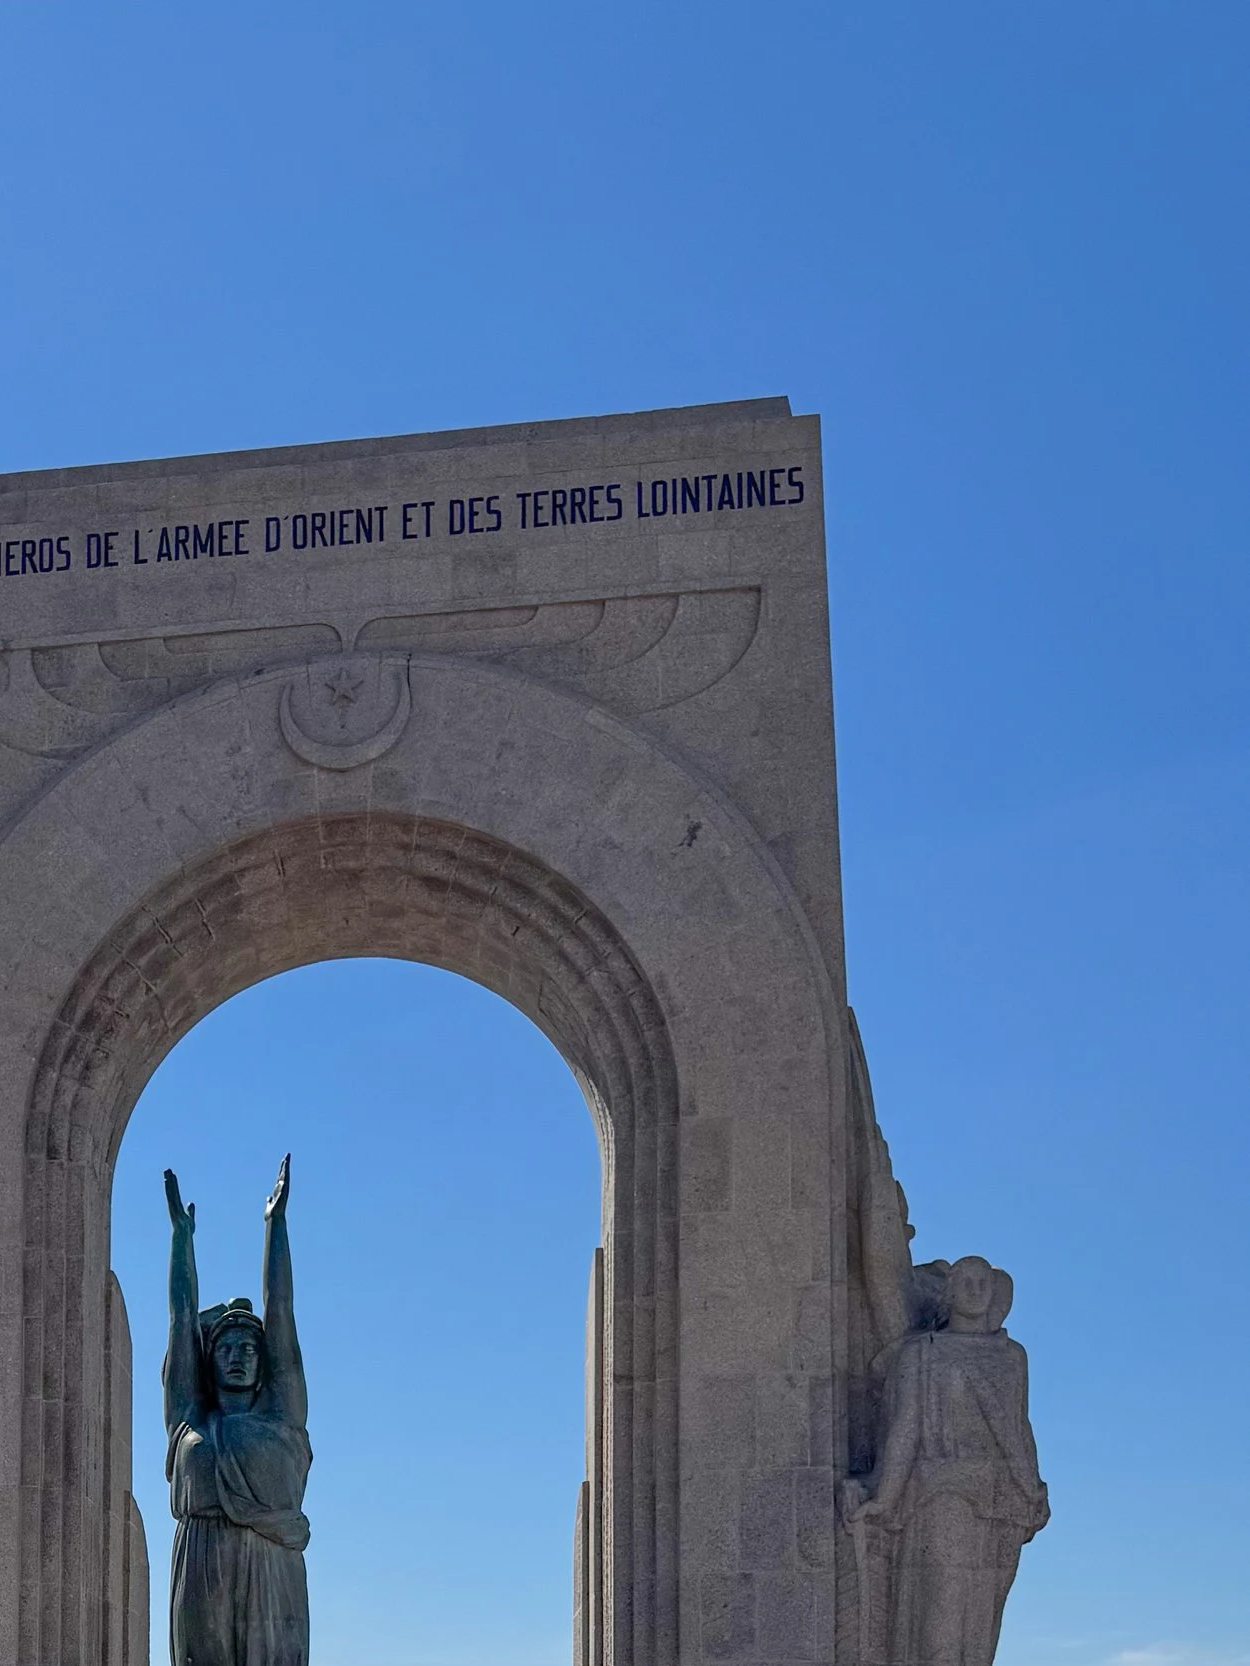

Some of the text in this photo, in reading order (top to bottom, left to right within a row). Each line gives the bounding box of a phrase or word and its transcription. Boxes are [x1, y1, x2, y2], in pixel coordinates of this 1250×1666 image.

[86, 531, 120, 570] DE
[134, 519, 250, 564] L'ARMEE
[264, 506, 388, 553] D'ORIENT
[402, 502, 436, 540] ET
[449, 496, 502, 536] DES
[516, 484, 623, 530] TERRES
[637, 467, 805, 519] LOINTAINES
